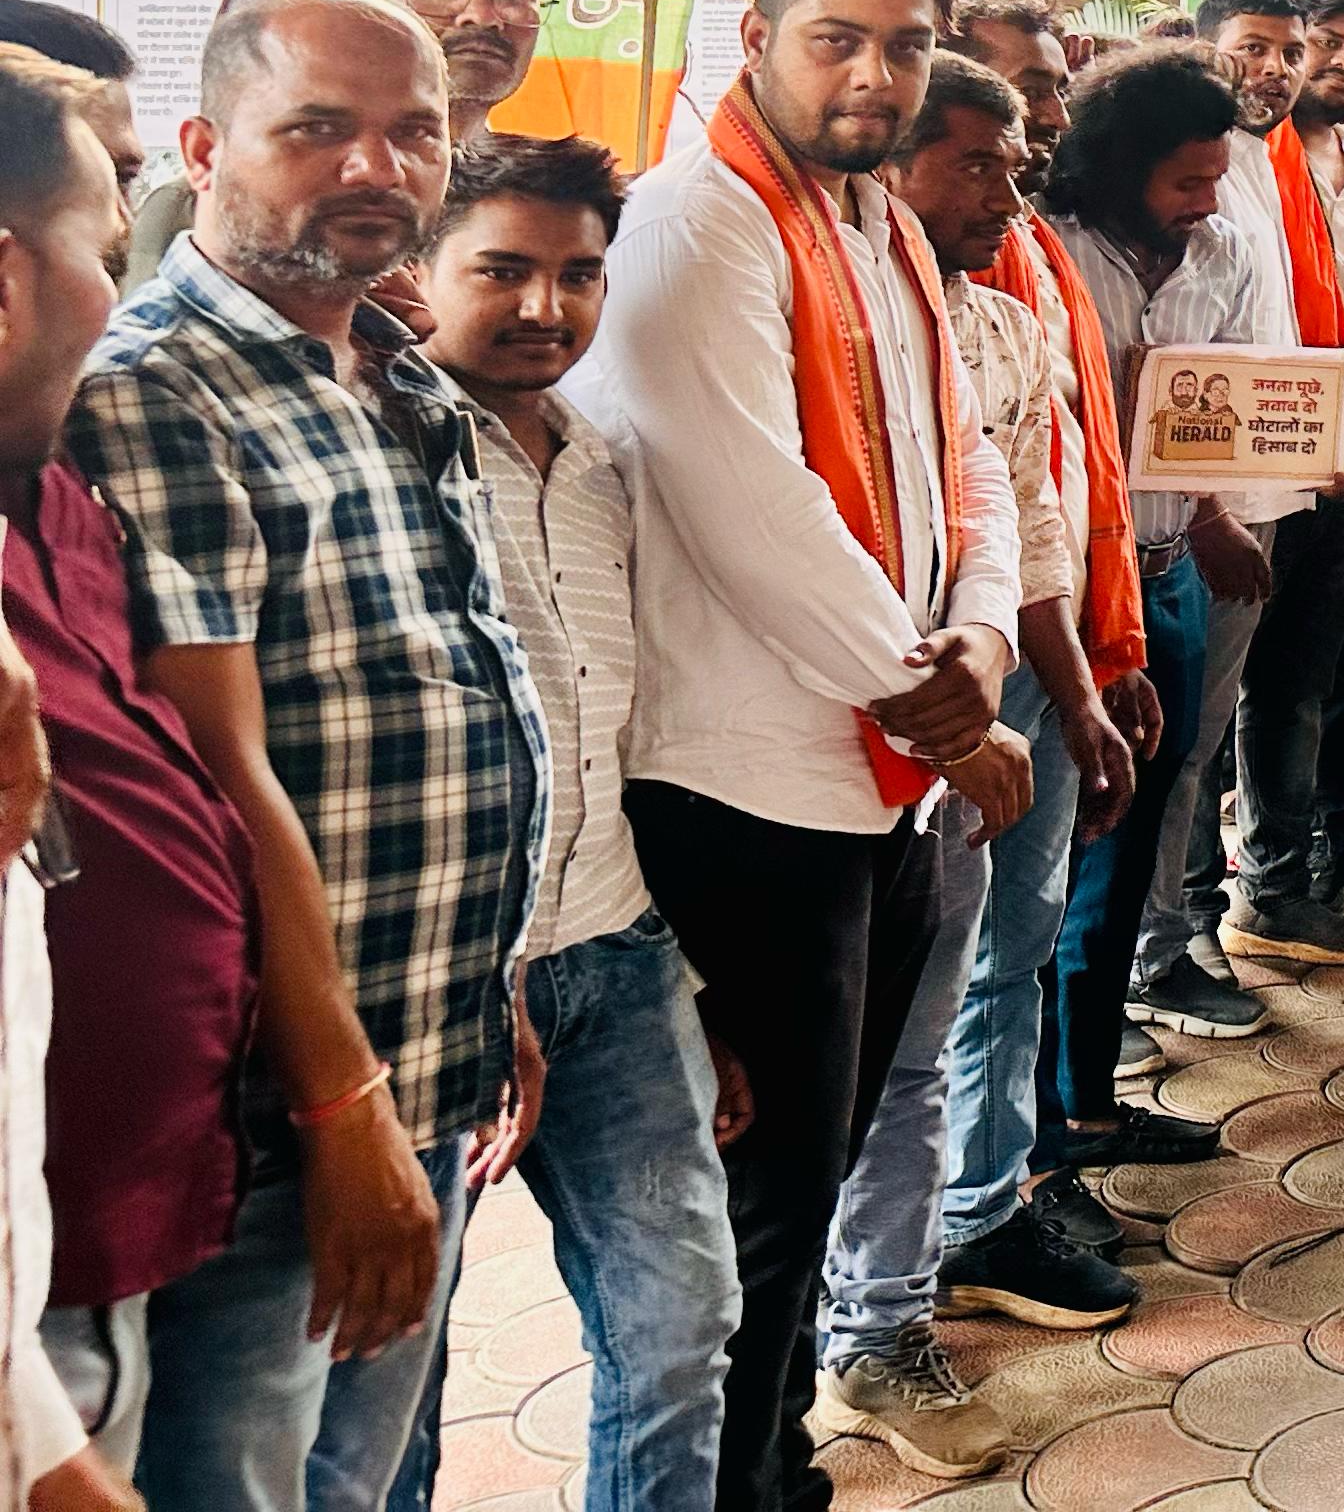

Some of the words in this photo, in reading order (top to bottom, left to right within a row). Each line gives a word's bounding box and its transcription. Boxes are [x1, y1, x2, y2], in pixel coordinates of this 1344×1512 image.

[1251, 378, 1292, 393] जनता
[1296, 377, 1325, 398] पूछे,
[1255, 398, 1298, 412] जवाब
[1302, 397, 1318, 414] दो
[1178, 415, 1223, 426] National
[1247, 415, 1301, 433] घोटालों
[1303, 420, 1324, 434] का
[1170, 425, 1232, 442] HERALD
[1251, 437, 1297, 455] हिसाब
[1301, 439, 1317, 455] दो
